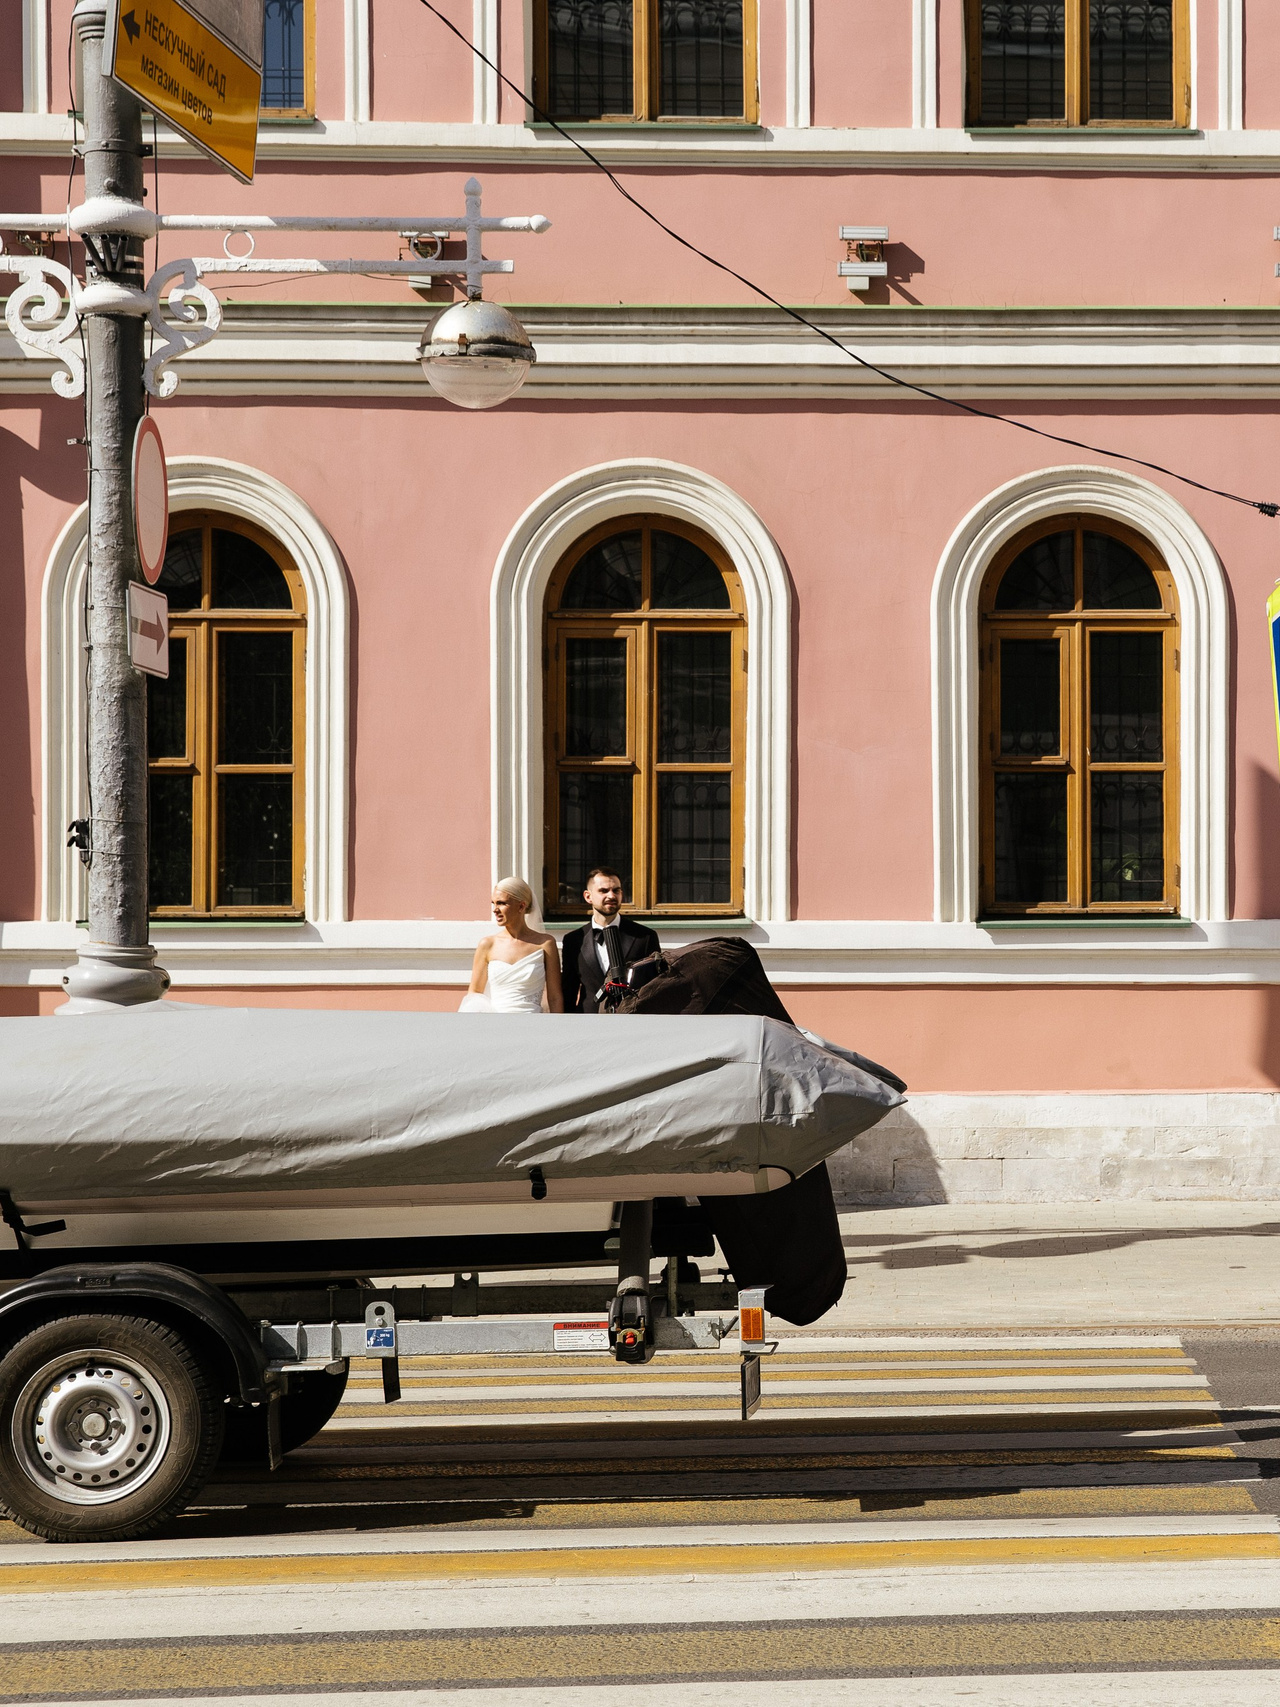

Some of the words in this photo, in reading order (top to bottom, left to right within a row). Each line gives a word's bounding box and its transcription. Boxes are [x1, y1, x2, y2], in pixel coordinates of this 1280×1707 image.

[141, 54, 180, 98] магазин
[181, 87, 213, 125] цветов
[144, 9, 206, 81] НЕСКУЧНЫЙ
[207, 63, 227, 103] САД
